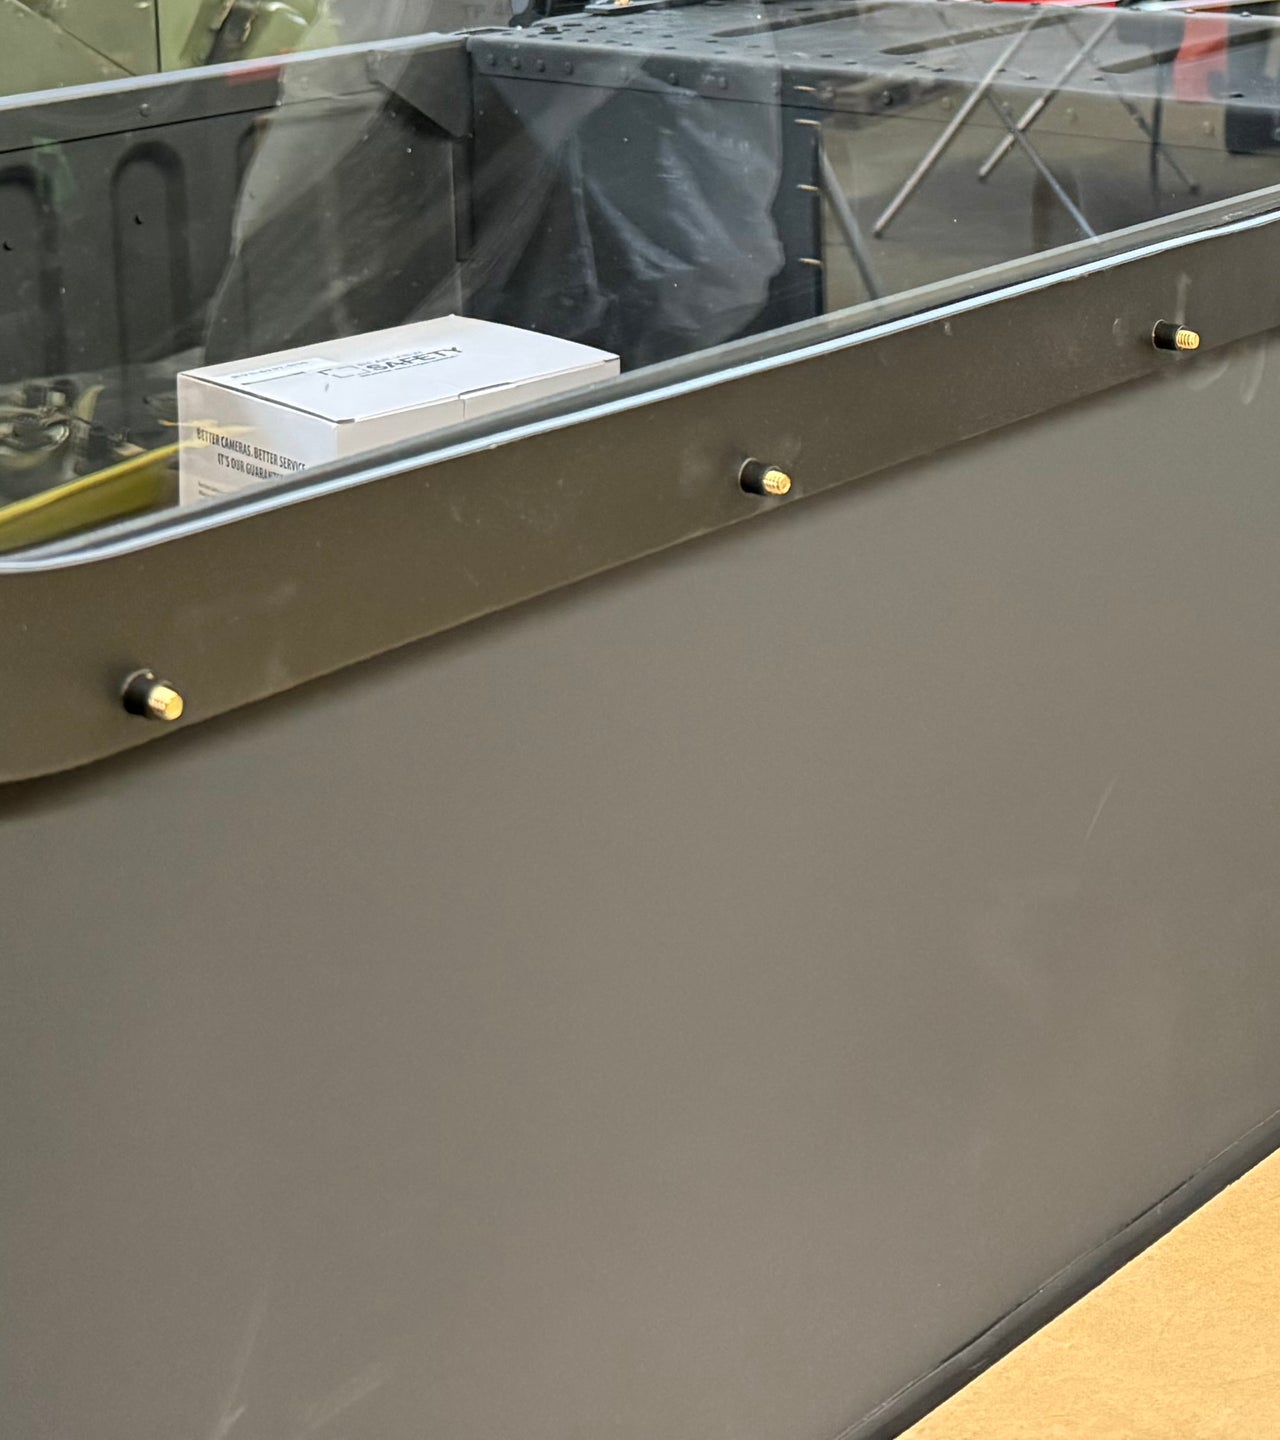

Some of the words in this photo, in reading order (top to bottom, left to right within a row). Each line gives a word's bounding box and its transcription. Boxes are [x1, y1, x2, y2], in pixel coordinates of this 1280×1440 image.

[366, 347, 462, 371] SAFETY
[196, 427, 220, 446] BETTER
[220, 436, 253, 457] CAMERAS.
[253, 447, 279, 466] BETTER
[217, 453, 230, 468] IT'S
[231, 458, 245, 473] OUR
